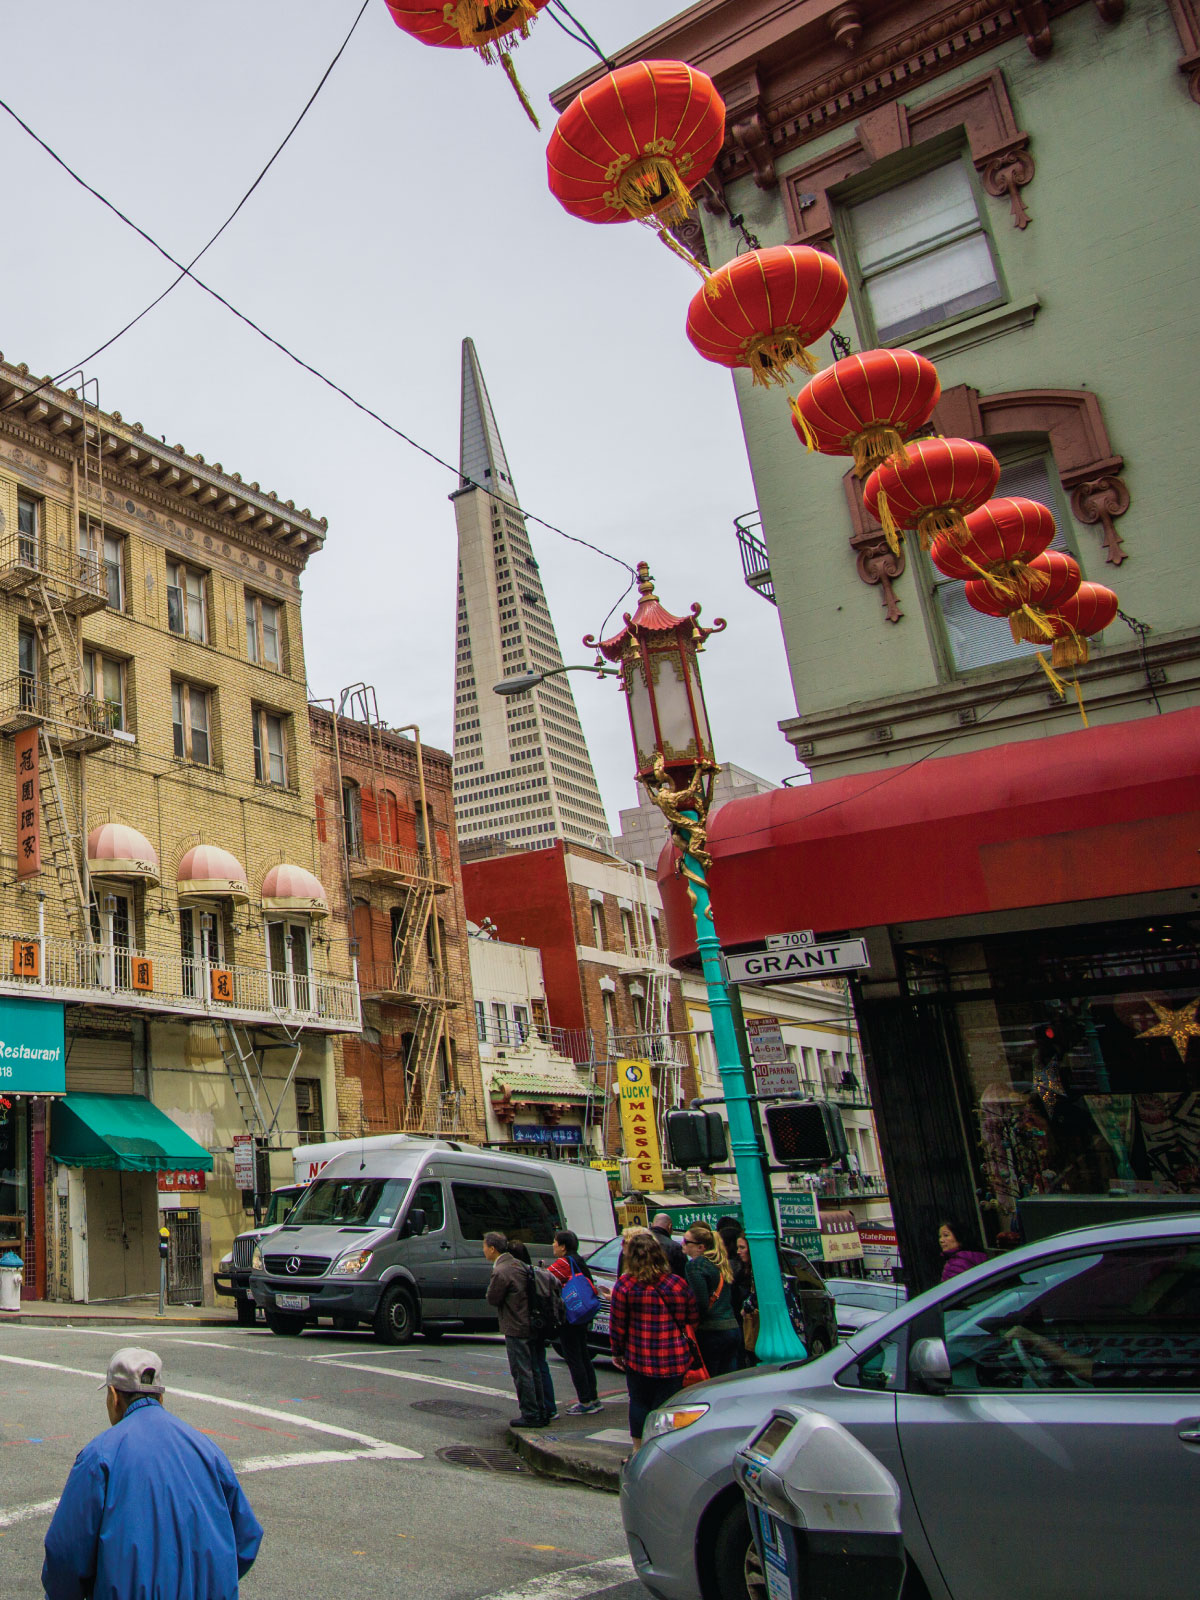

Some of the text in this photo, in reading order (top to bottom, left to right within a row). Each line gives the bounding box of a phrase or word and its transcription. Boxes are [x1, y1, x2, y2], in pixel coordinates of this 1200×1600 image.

[135, 861, 156, 874] Kan's
[783, 933, 808, 945] 700
[745, 948, 840, 975] GRANT
[756, 1065, 795, 1076] NO PARKING
[621, 1085, 650, 1099] LUCKY
[629, 1102, 653, 1183] MASSAGE
[860, 1232, 896, 1241] State Farm
